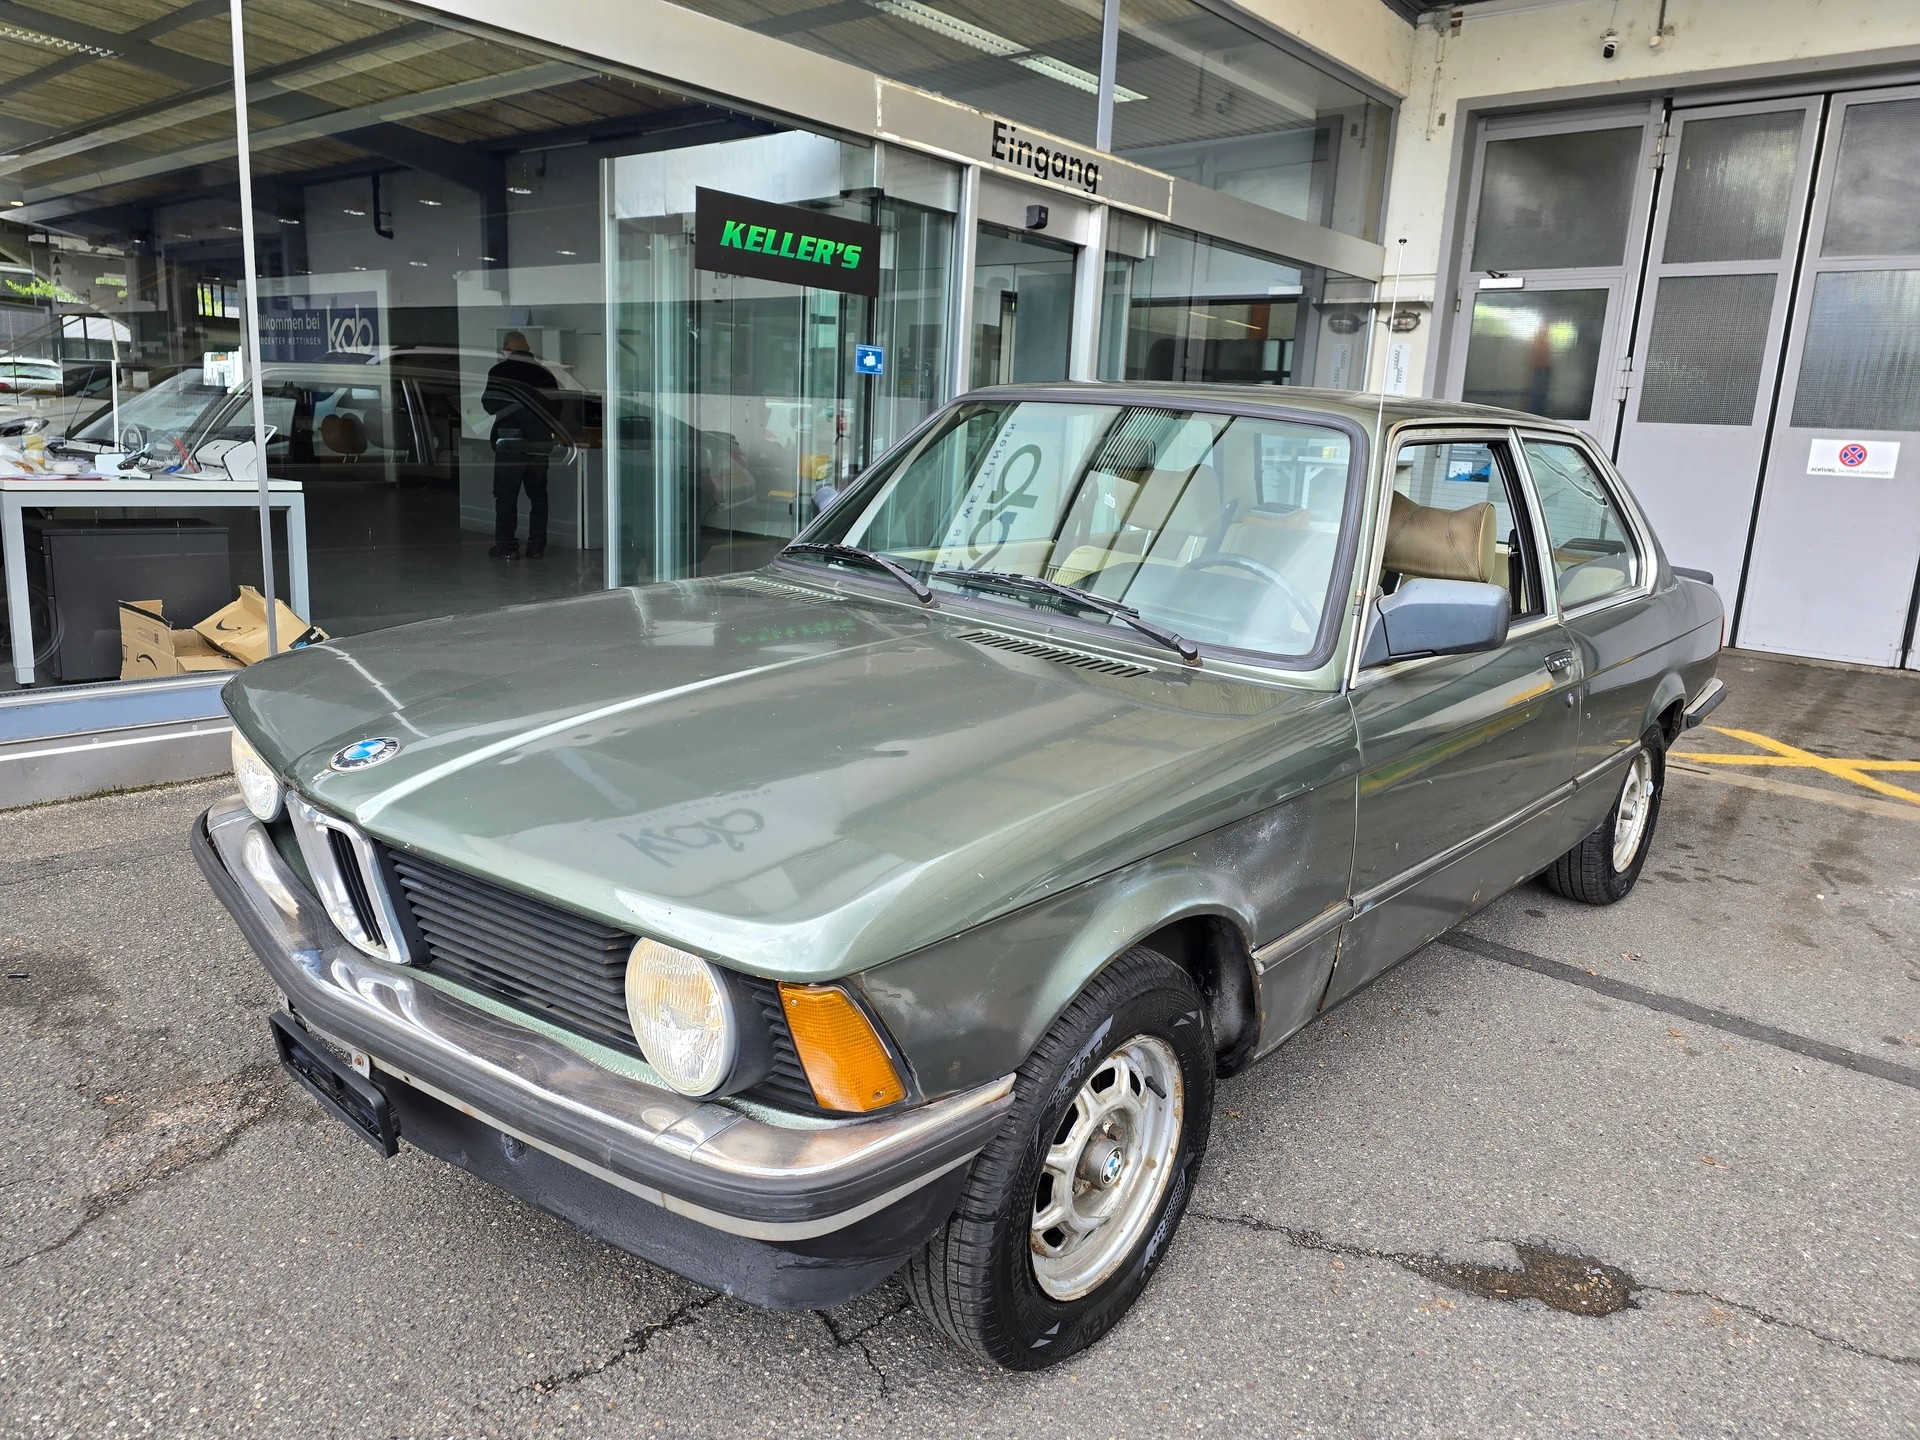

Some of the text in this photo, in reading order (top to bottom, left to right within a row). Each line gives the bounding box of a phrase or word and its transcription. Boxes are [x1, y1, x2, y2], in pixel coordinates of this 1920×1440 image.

[991, 120, 1099, 194] Eingang
[719, 220, 862, 269] KELLER'S
[258, 312, 320, 331] illkommen bei
[288, 336, 322, 346] WETTINGEN
